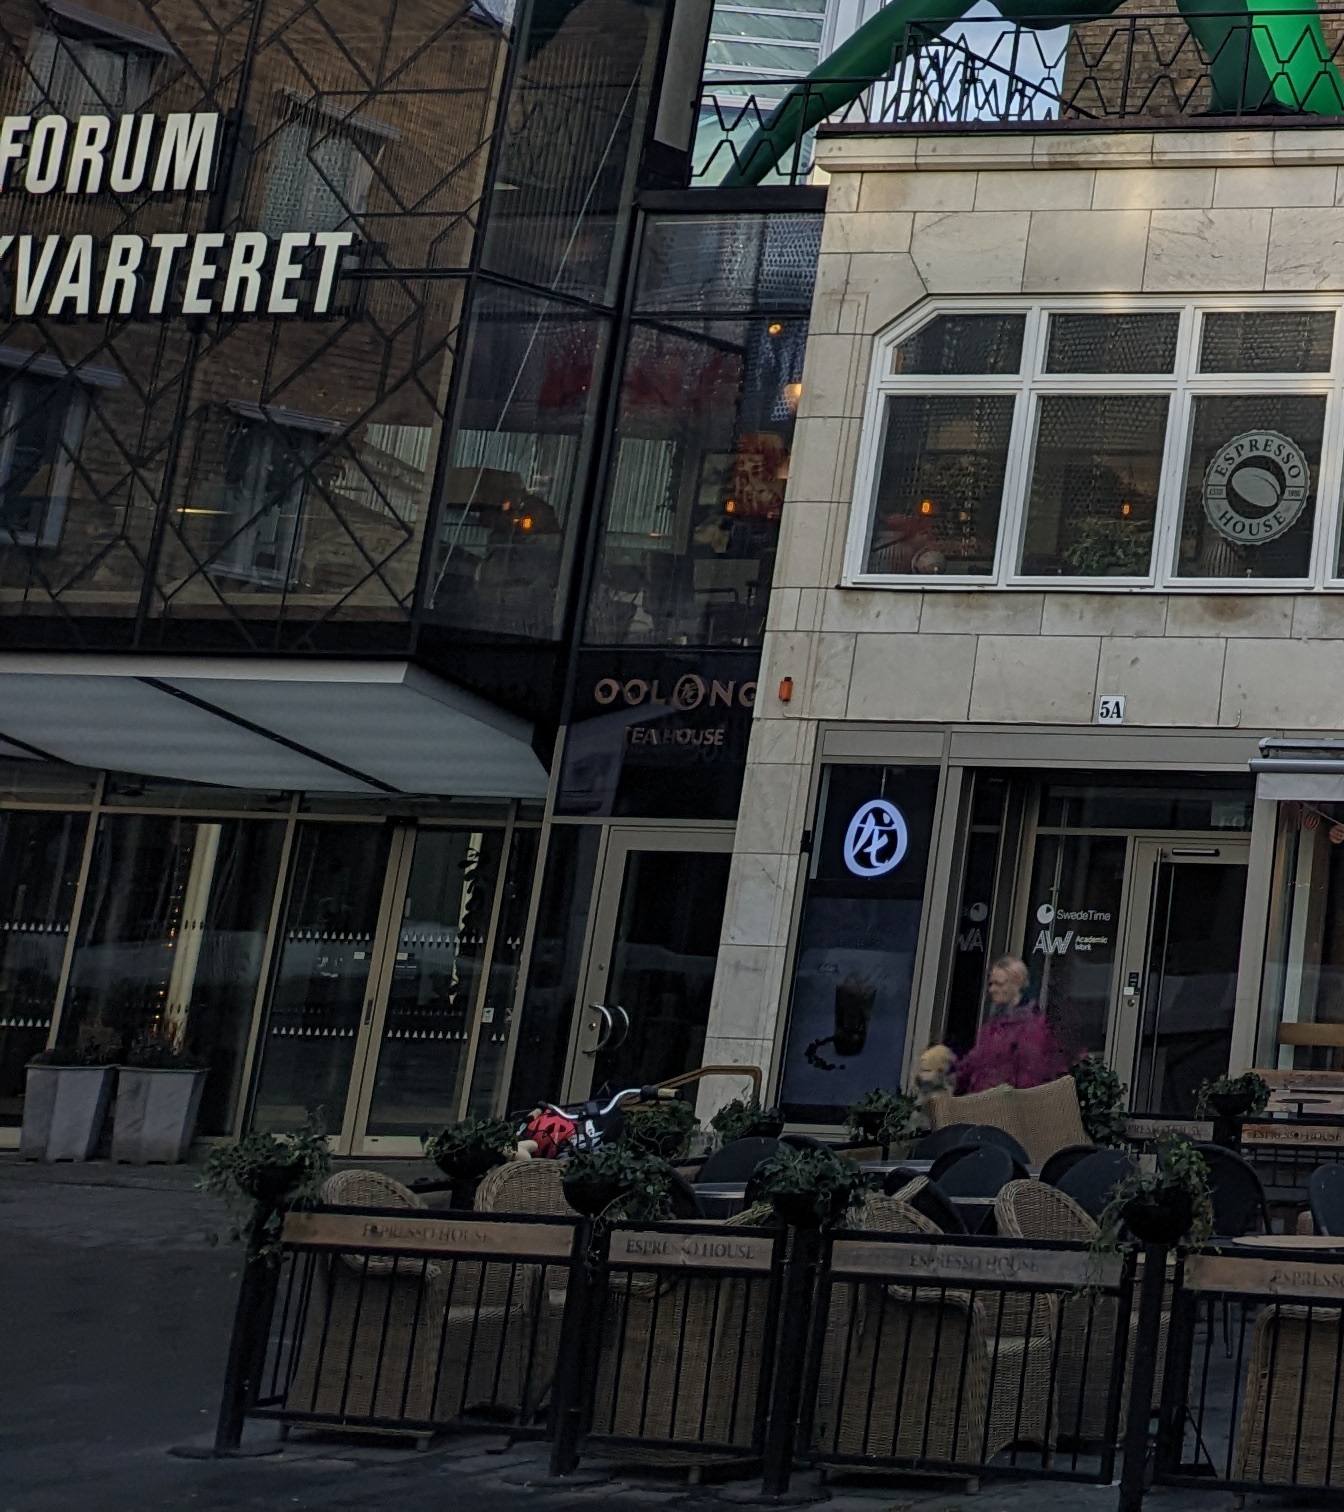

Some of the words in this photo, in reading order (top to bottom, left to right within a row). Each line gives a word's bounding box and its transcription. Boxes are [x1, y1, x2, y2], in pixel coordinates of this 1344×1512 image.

[0, 112, 219, 194] FORUM
[0, 232, 353, 316] VARTERET
[1214, 438, 1302, 480] ESPRESSO
[1217, 509, 1287, 537] HOUSE
[1100, 700, 1122, 719] 5A
[362, 1222, 435, 1240] EPRESSO
